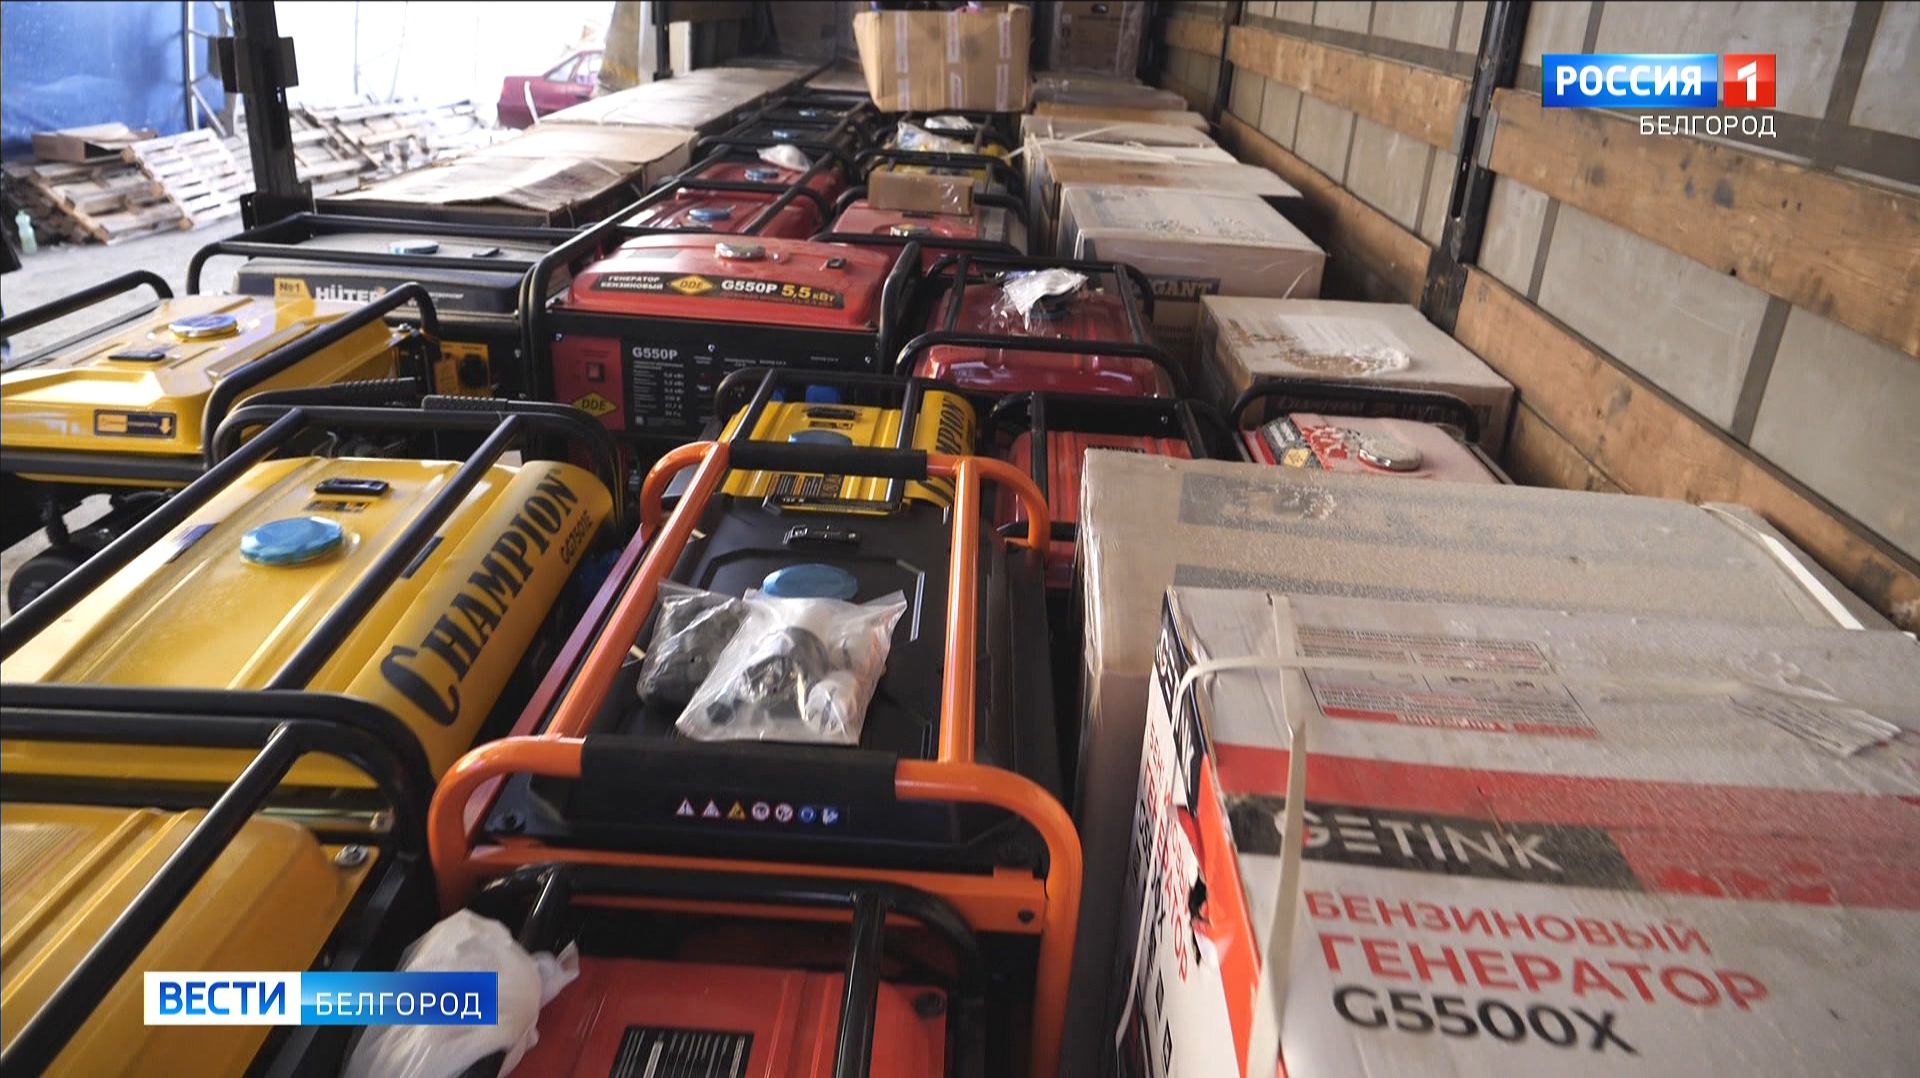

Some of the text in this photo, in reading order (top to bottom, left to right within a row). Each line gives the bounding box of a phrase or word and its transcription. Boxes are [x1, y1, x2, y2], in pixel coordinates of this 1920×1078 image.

[600, 281, 664, 291] БЕНЗИНОВЫЙ
[608, 275, 661, 283] ГЕНЕРАТОР
[679, 279, 703, 289] DDE
[721, 279, 778, 294] G550P
[781, 283, 812, 300] 5,5
[632, 346, 679, 360] G550P
[581, 399, 607, 412] DDE
[380, 469, 578, 726] CHAMPION
[1274, 811, 1562, 872] GETINK
[1304, 890, 1712, 956] БЕНЗИНОВЫЙ
[1319, 932, 1770, 1012] ГЕНЕРАТОР
[1333, 984, 1640, 1056] G5500X
